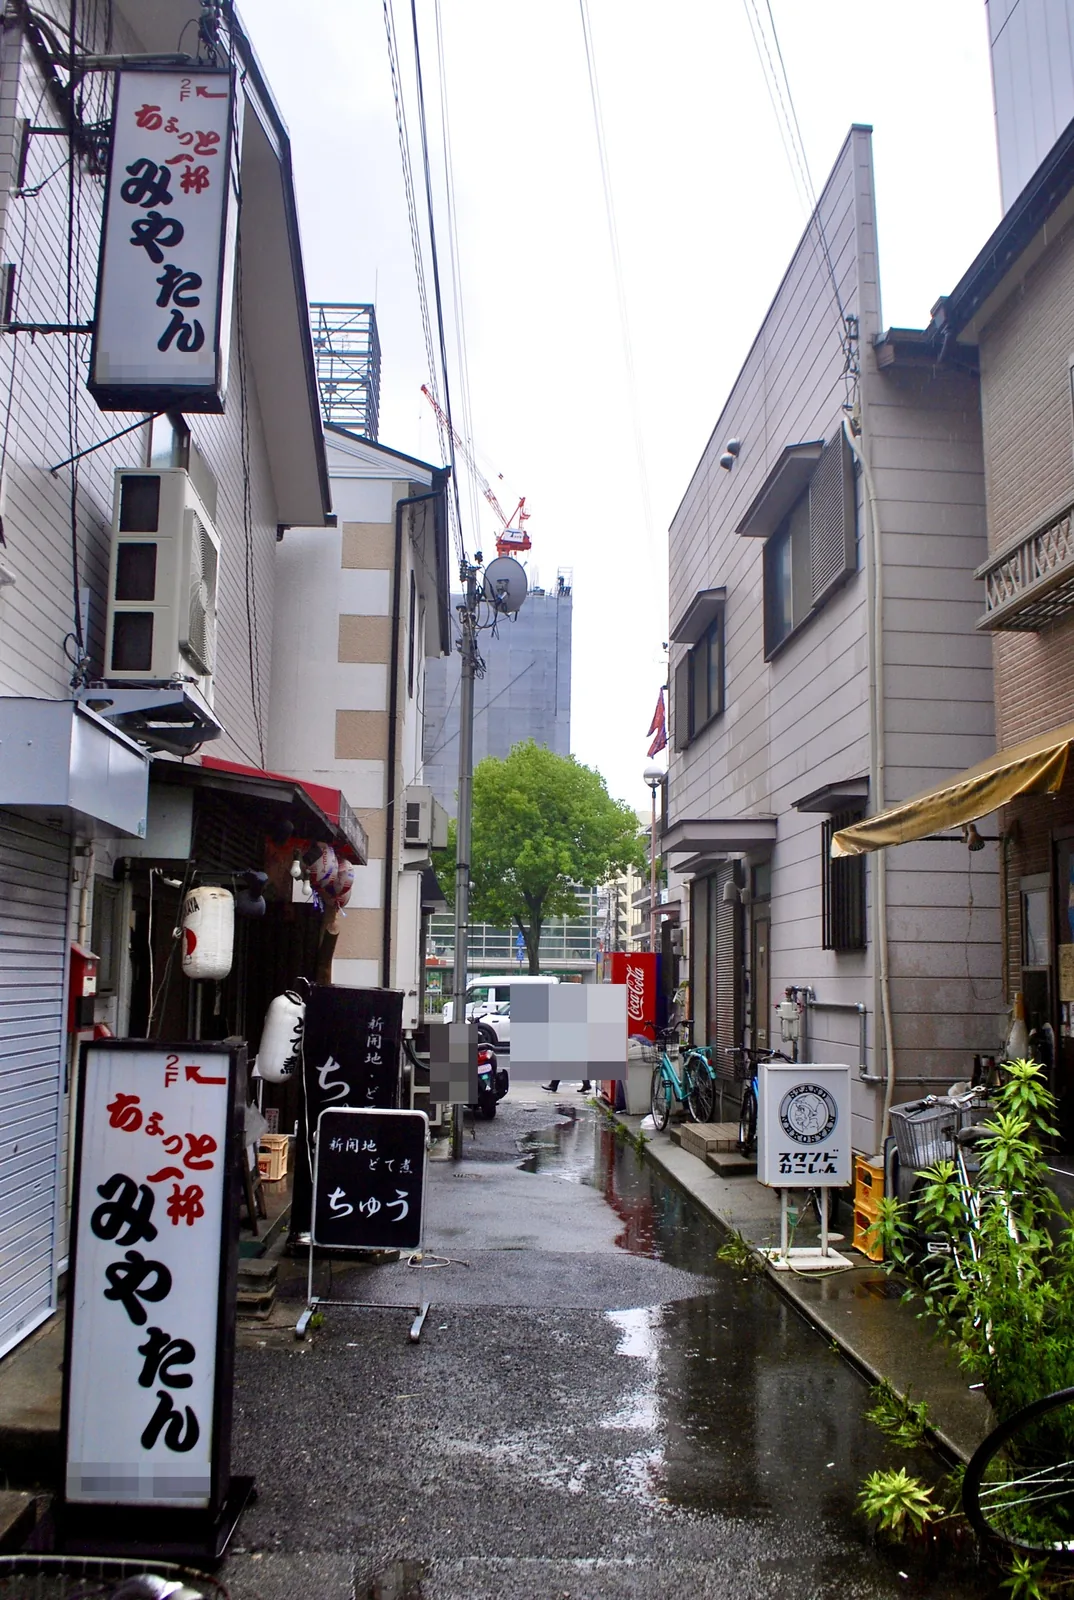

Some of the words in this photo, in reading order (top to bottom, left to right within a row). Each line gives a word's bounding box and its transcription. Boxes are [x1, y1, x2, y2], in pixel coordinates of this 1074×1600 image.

[120, 157, 205, 352] みやたん
[625, 963, 645, 1021] Coca-Cola
[788, 1084, 829, 1100] STAND
[329, 1137, 377, 1153] 新開地
[778, 1149, 839, 1162] スタンド
[368, 1157, 413, 1174] どて煮
[327, 1186, 409, 1222] ちゅう
[90, 1172, 200, 1453] みやたん
